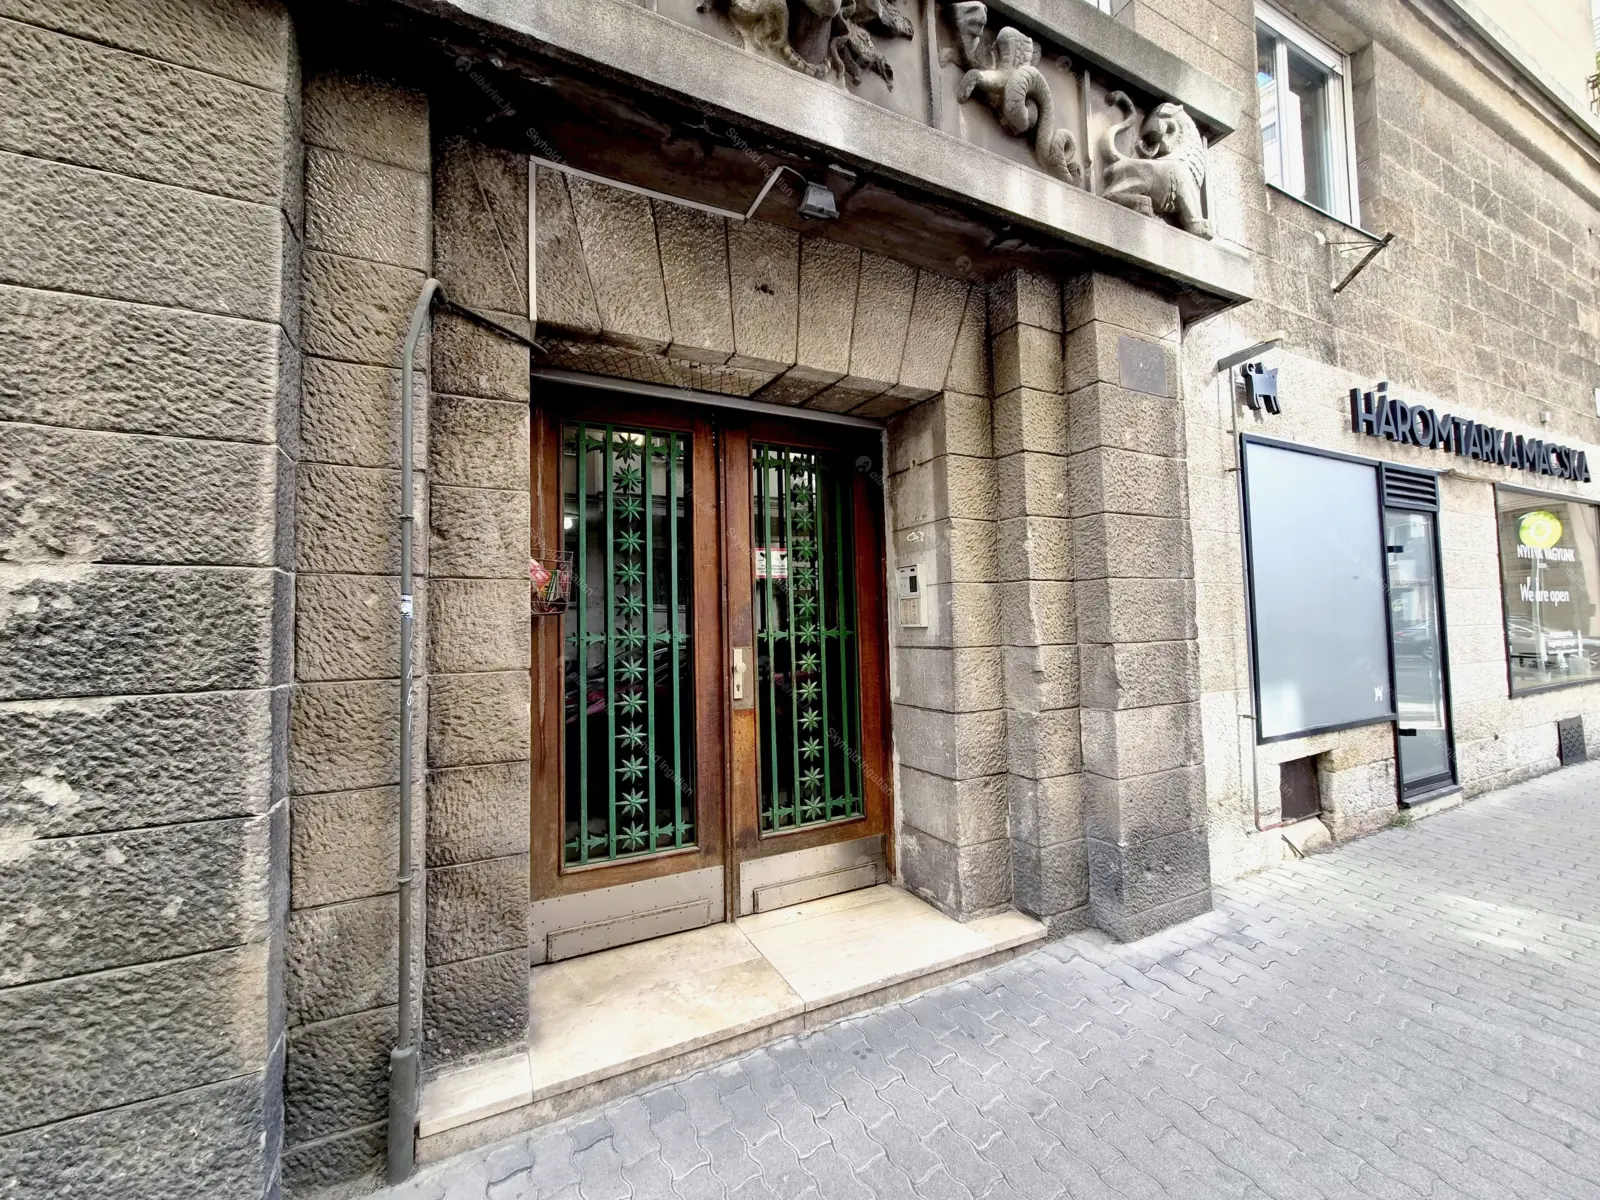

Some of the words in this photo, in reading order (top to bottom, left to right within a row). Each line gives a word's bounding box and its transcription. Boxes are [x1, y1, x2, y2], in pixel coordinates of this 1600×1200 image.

[1519, 577, 1534, 602] We
[1535, 590, 1549, 602] are
[1550, 590, 1570, 607] open
